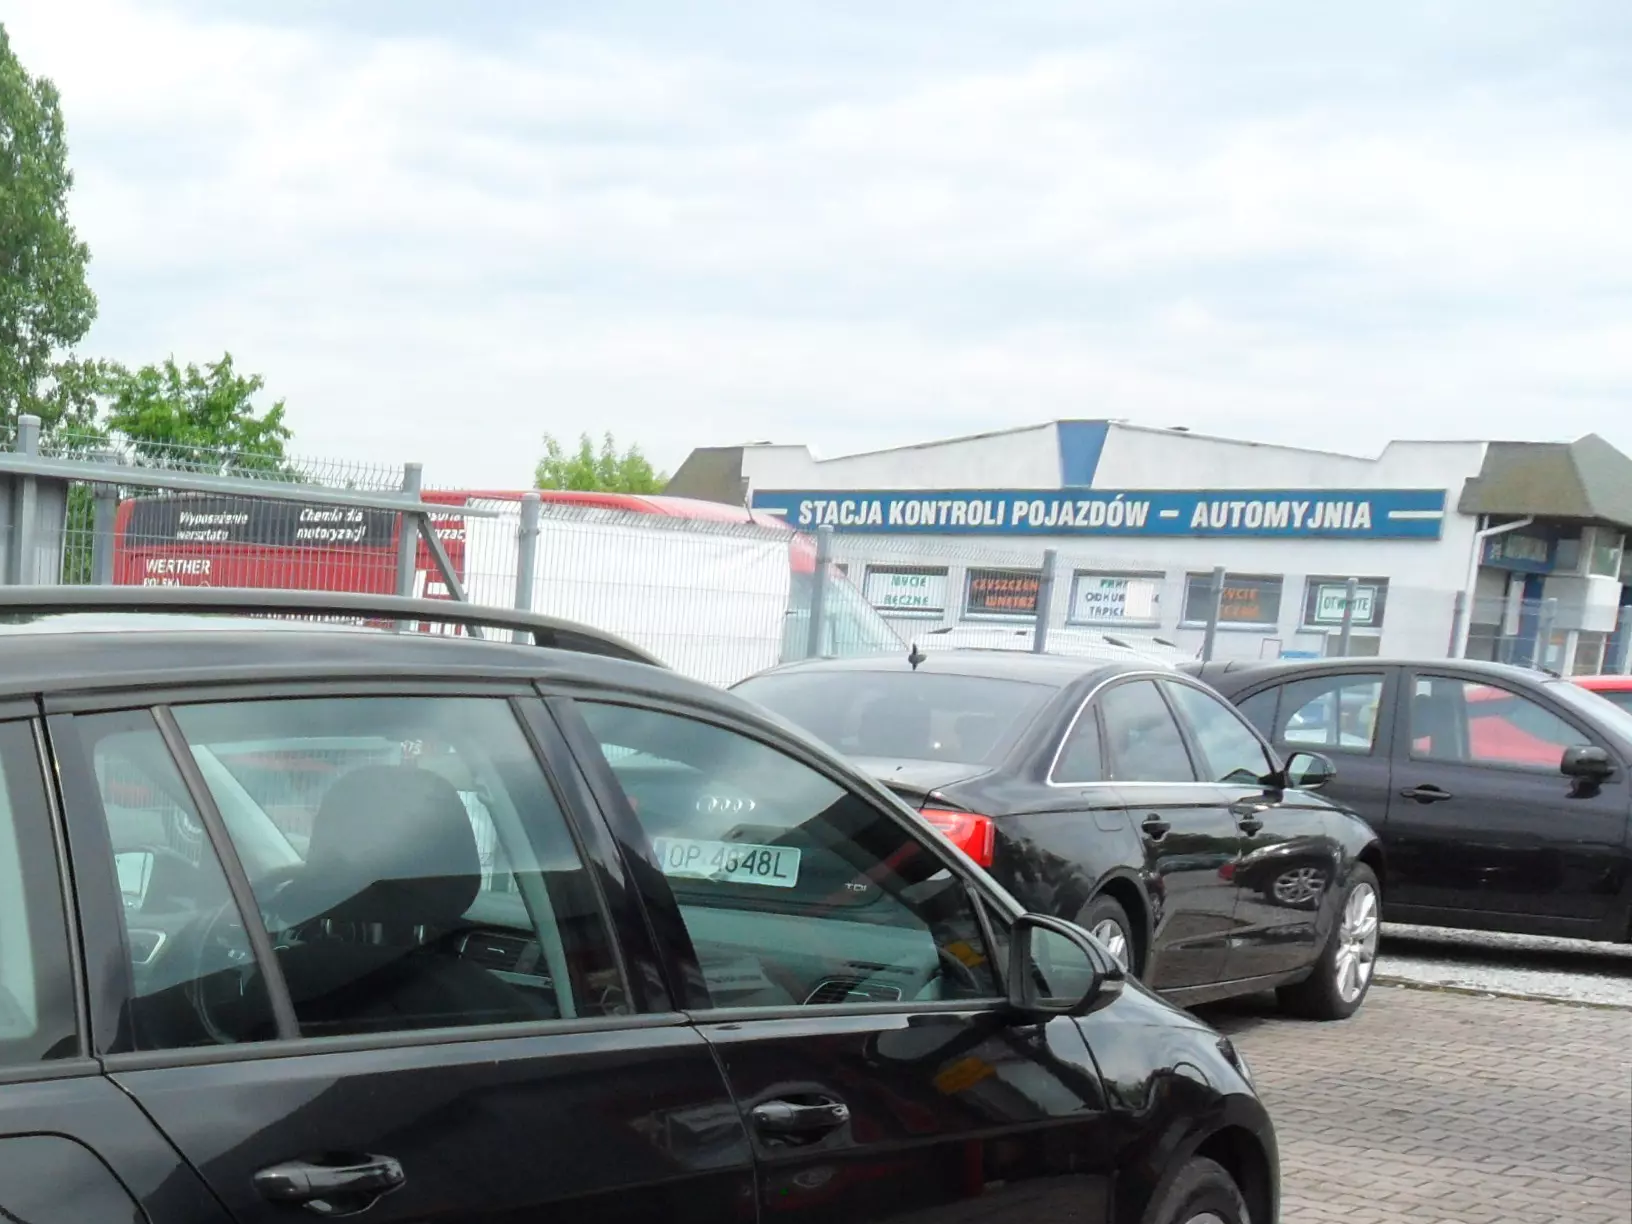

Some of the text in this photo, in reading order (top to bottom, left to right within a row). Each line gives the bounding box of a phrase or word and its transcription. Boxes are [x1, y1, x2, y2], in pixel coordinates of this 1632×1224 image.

[798, 500, 882, 525] STACJA
[888, 500, 1004, 526] KONTROLI
[1011, 494, 1149, 527] POJAZDÓW
[1191, 501, 1371, 528] AUTOMYJNIA
[146, 558, 211, 574] WERTHER
[670, 844, 700, 868] OP
[844, 882, 867, 892] TDI
